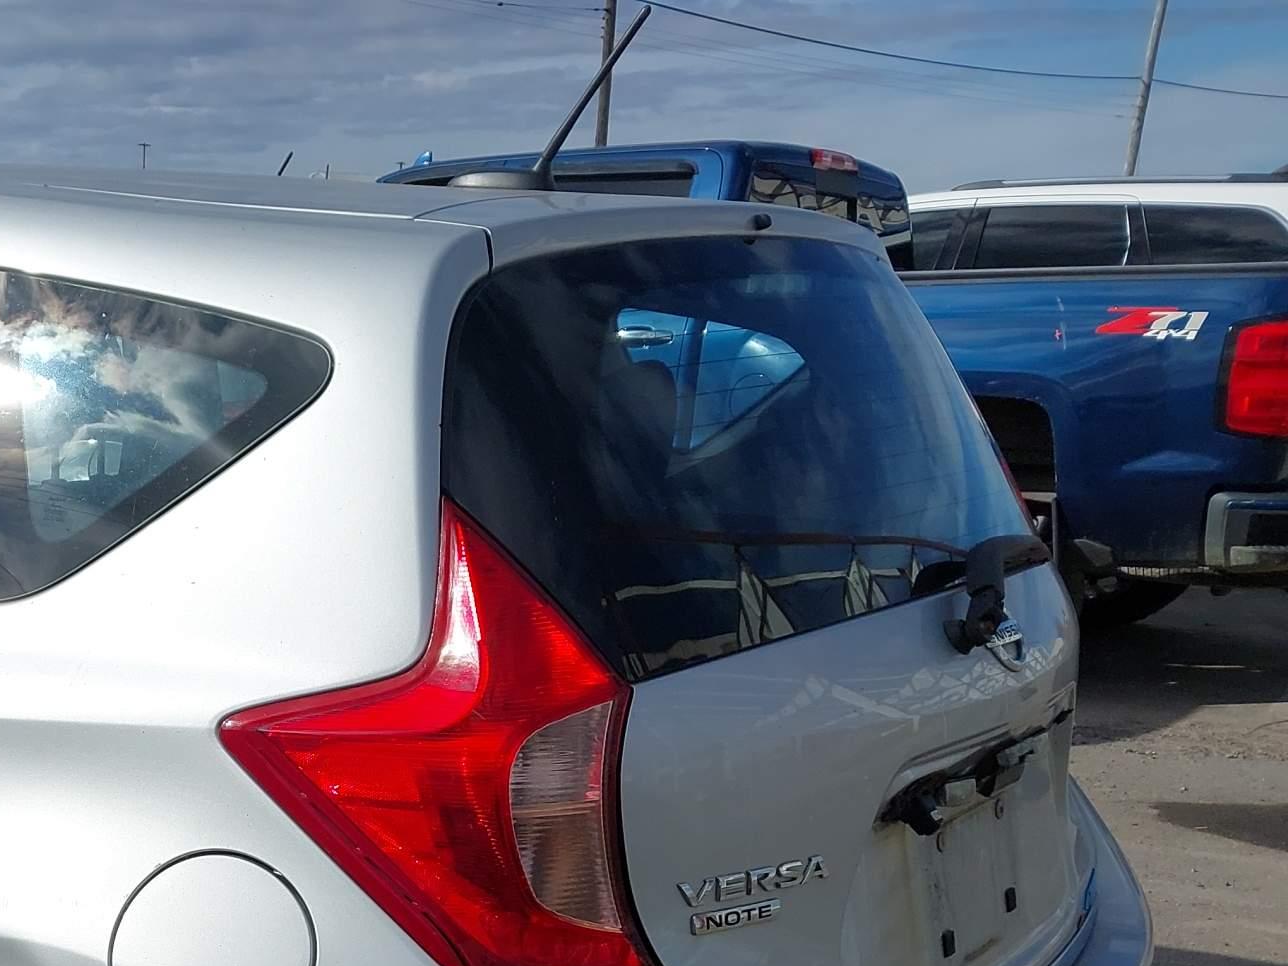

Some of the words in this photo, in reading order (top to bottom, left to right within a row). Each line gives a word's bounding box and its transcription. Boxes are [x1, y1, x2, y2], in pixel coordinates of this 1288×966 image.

[1095, 306, 1210, 335] Z71
[676, 854, 830, 907] VERSA
[705, 904, 773, 930] NOTE
